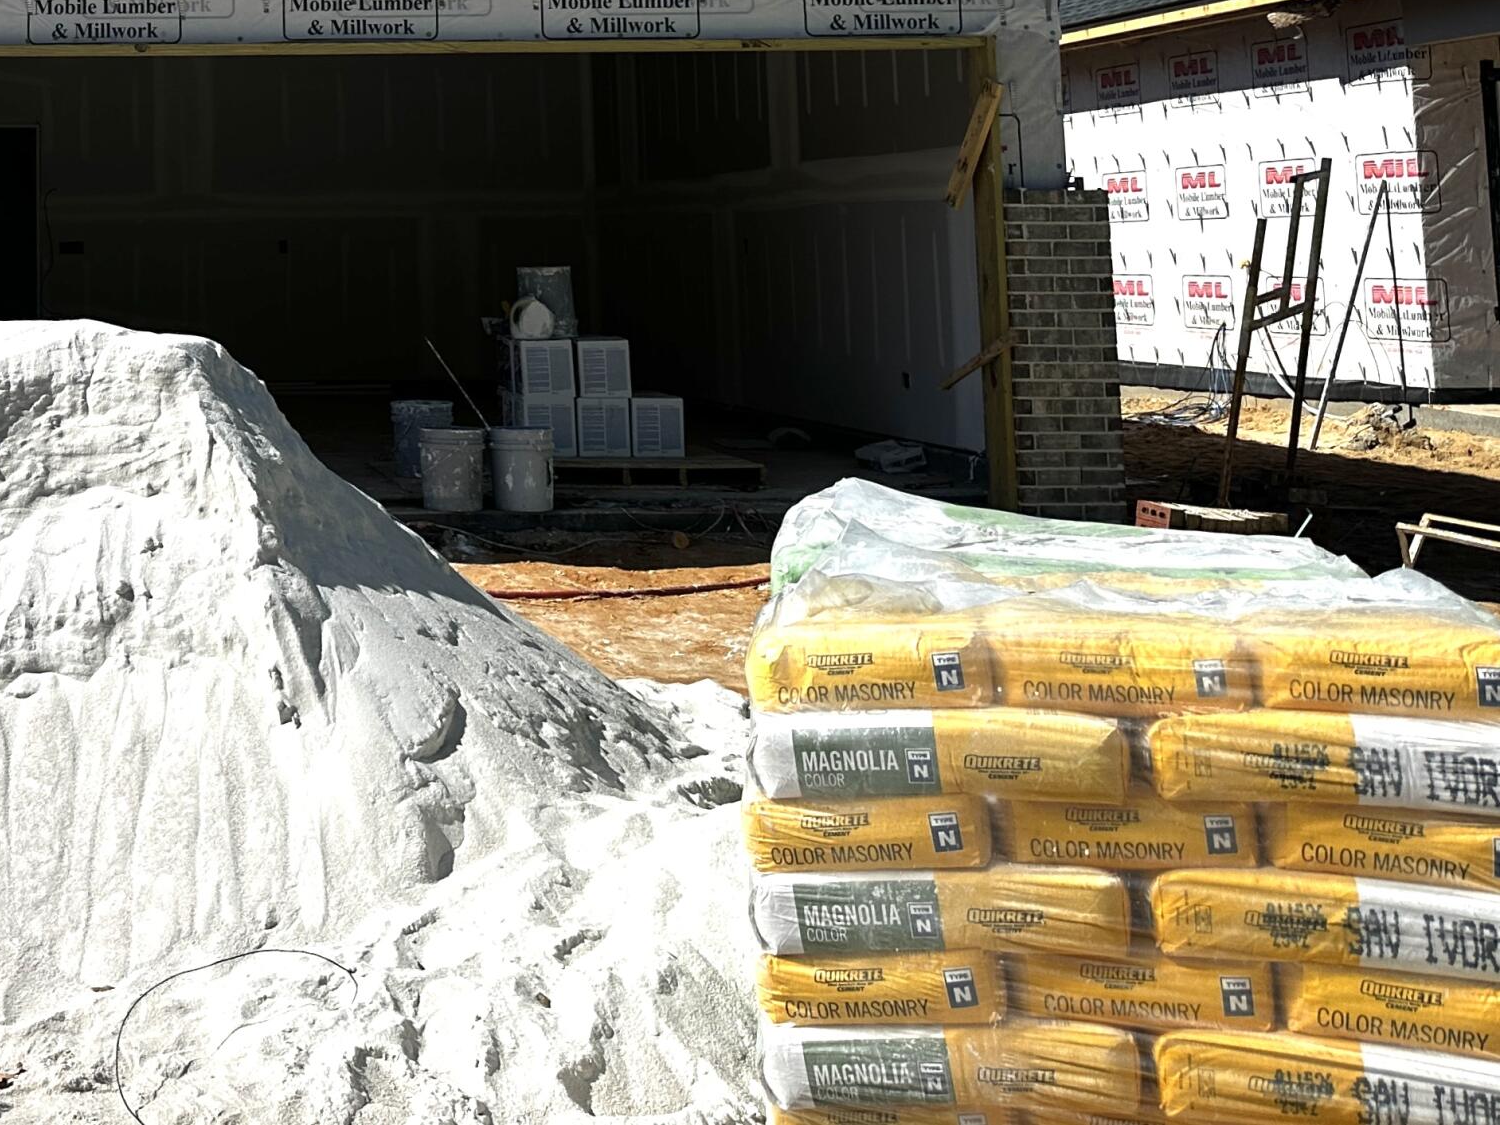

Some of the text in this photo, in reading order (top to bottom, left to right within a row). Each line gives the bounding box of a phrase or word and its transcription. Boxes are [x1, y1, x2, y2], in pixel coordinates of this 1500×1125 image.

[35, 0, 97, 15] Mobile
[308, 19, 415, 36] & Millwork
[566, 17, 676, 34] & Millwork
[829, 13, 940, 31] & Millwork
[52, 22, 158, 40] & Millwork
[1107, 177, 1143, 194] ML
[1181, 171, 1221, 190] ML
[1113, 280, 1149, 296] ML
[1188, 281, 1228, 299] ML
[807, 653, 873, 666] QUIKRETE
[1331, 651, 1409, 669] QUIKRETE
[941, 670, 959, 686] N
[1202, 676, 1221, 692] N
[778, 681, 915, 704] COLOR MASONRY
[1023, 680, 1175, 704] COLOR MASONRY
[1290, 679, 1455, 710] COLOR MASONRY
[1486, 684, 1500, 702] N
[802, 749, 899, 772] MAGNOLIA
[964, 754, 1041, 770] QUIKRETE
[804, 773, 845, 787] COLOR
[914, 765, 929, 778] N
[801, 813, 869, 828] QUIKRETE
[1066, 807, 1140, 822] QUIKRETE
[1344, 814, 1425, 837] QUIKRETE
[938, 830, 957, 846] N
[1213, 833, 1231, 849] N
[771, 842, 913, 865] COLOR MASONRY
[1030, 838, 1185, 860] COLOR MASONRY
[1301, 842, 1470, 880] COLOR MASONRY
[804, 904, 901, 927] MAGNOLIA
[967, 908, 1044, 924] QUIKRETE
[806, 927, 848, 942] COLOR
[916, 919, 931, 933] N
[814, 968, 884, 983] QUIKRETE
[953, 986, 972, 1003] N
[1361, 979, 1443, 1007] QUIKRETE
[785, 999, 928, 1019] COLOR MASONRY
[1044, 994, 1201, 1021] COLOR MASONRY
[1229, 995, 1247, 1011] N
[1317, 1007, 1489, 1051] COLOR MASONRY
[813, 1062, 912, 1087] MAGNOLIA
[978, 1067, 1056, 1084] QUIKRETE
[927, 1078, 942, 1091] N
[816, 1086, 858, 1101] COLOR
